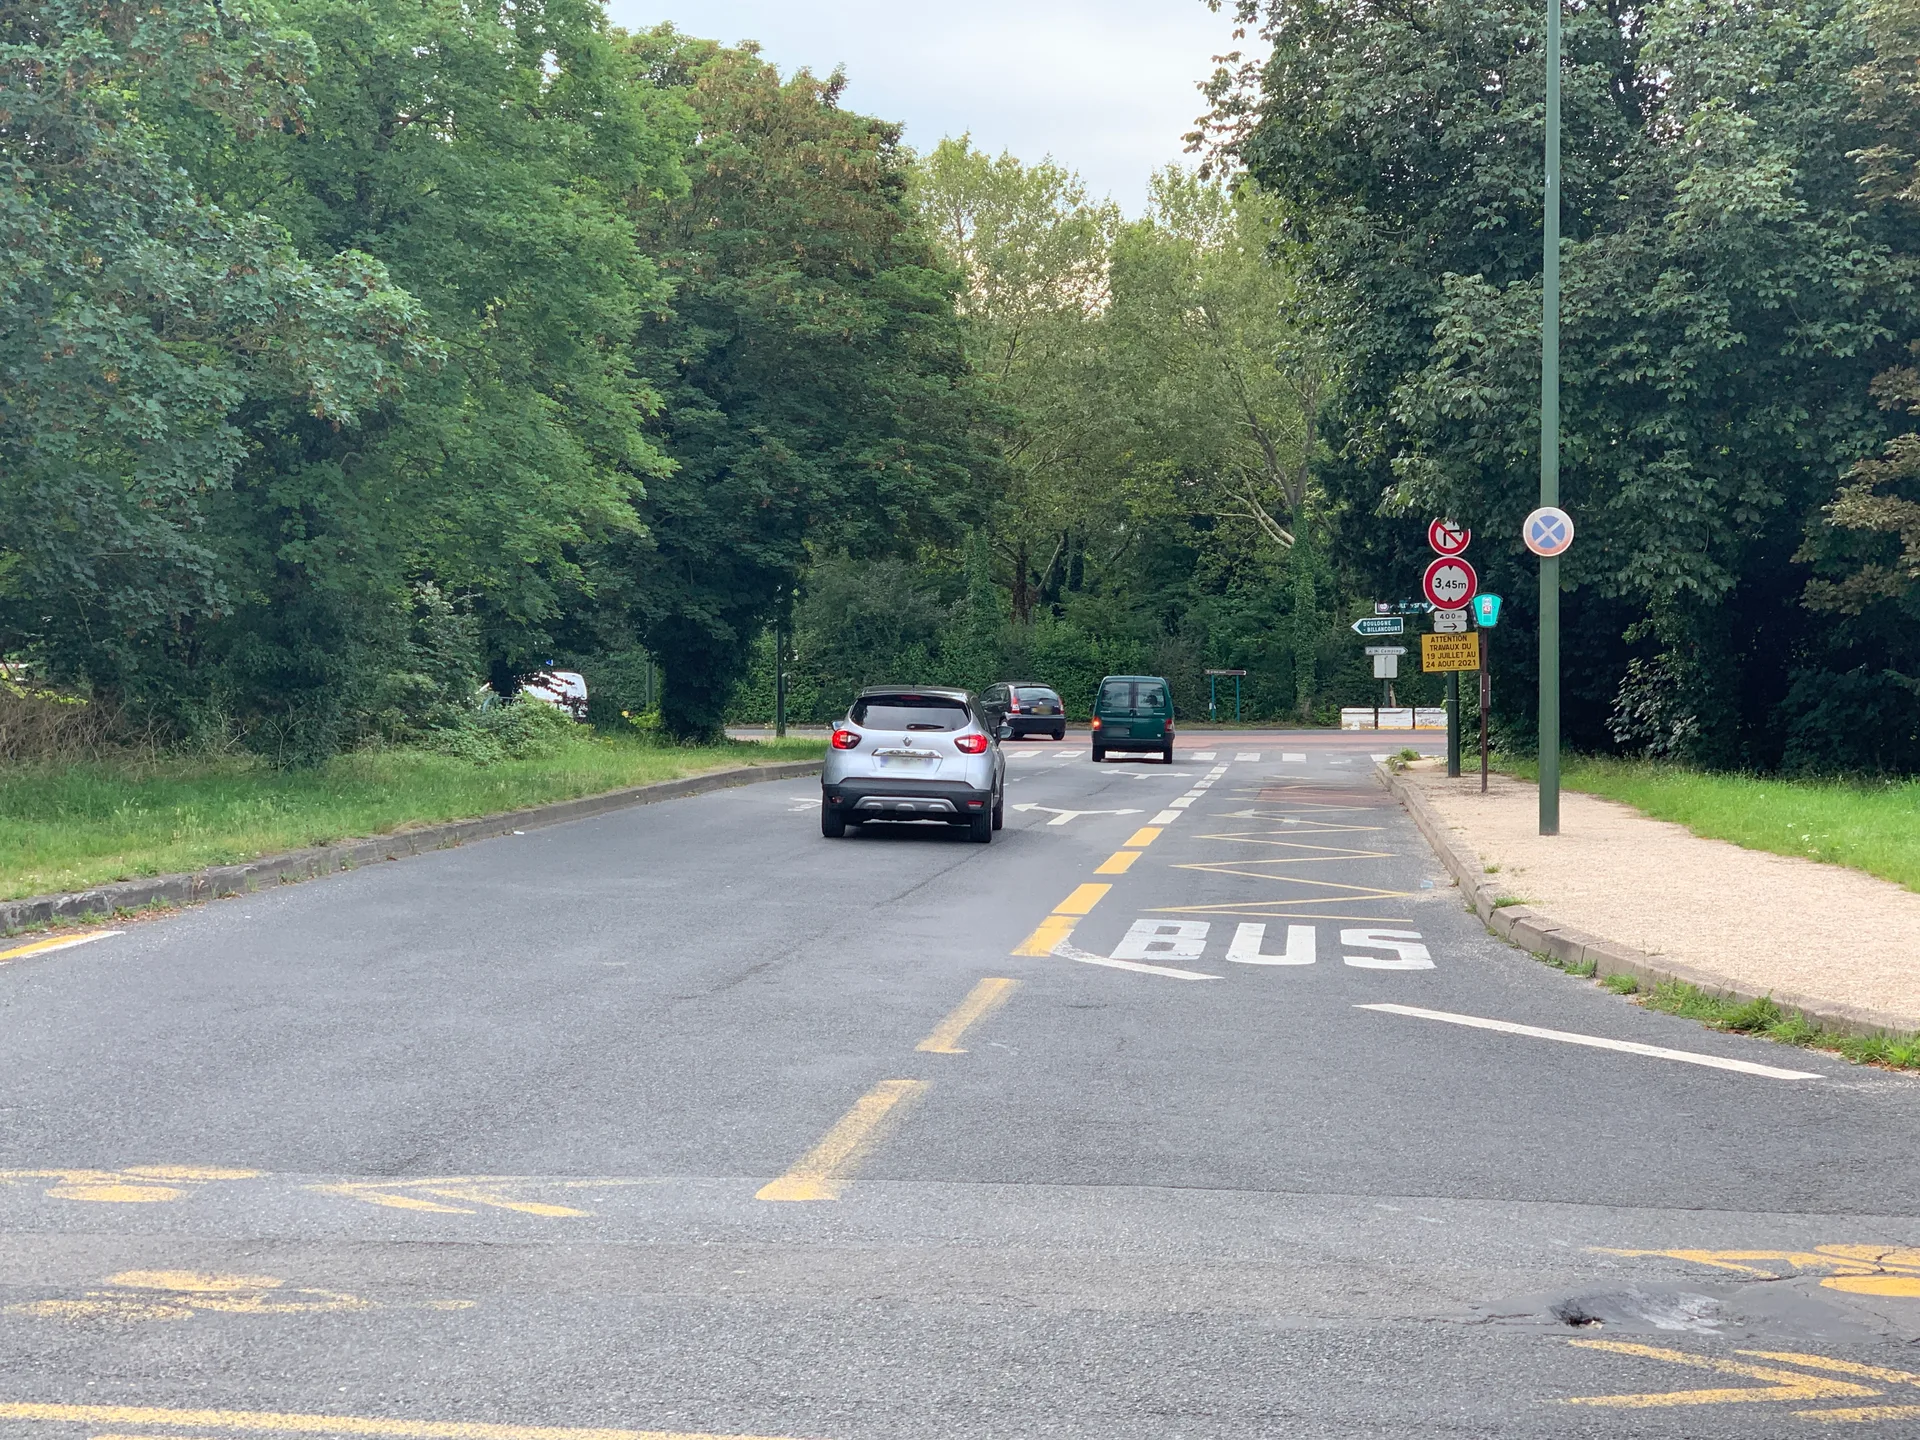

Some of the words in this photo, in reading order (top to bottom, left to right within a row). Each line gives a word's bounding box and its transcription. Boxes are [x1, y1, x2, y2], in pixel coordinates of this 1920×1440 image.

[1434, 577, 1467, 590] 3,45m
[1430, 634, 1468, 643] ATTENTION
[1430, 643, 1460, 651] TRAVAUX
[1461, 642, 1472, 650] DU
[1426, 652, 1436, 660] 19
[1437, 651, 1464, 659] JUILLET
[1457, 659, 1476, 667] 2021
[1109, 919, 1437, 970] BUS
